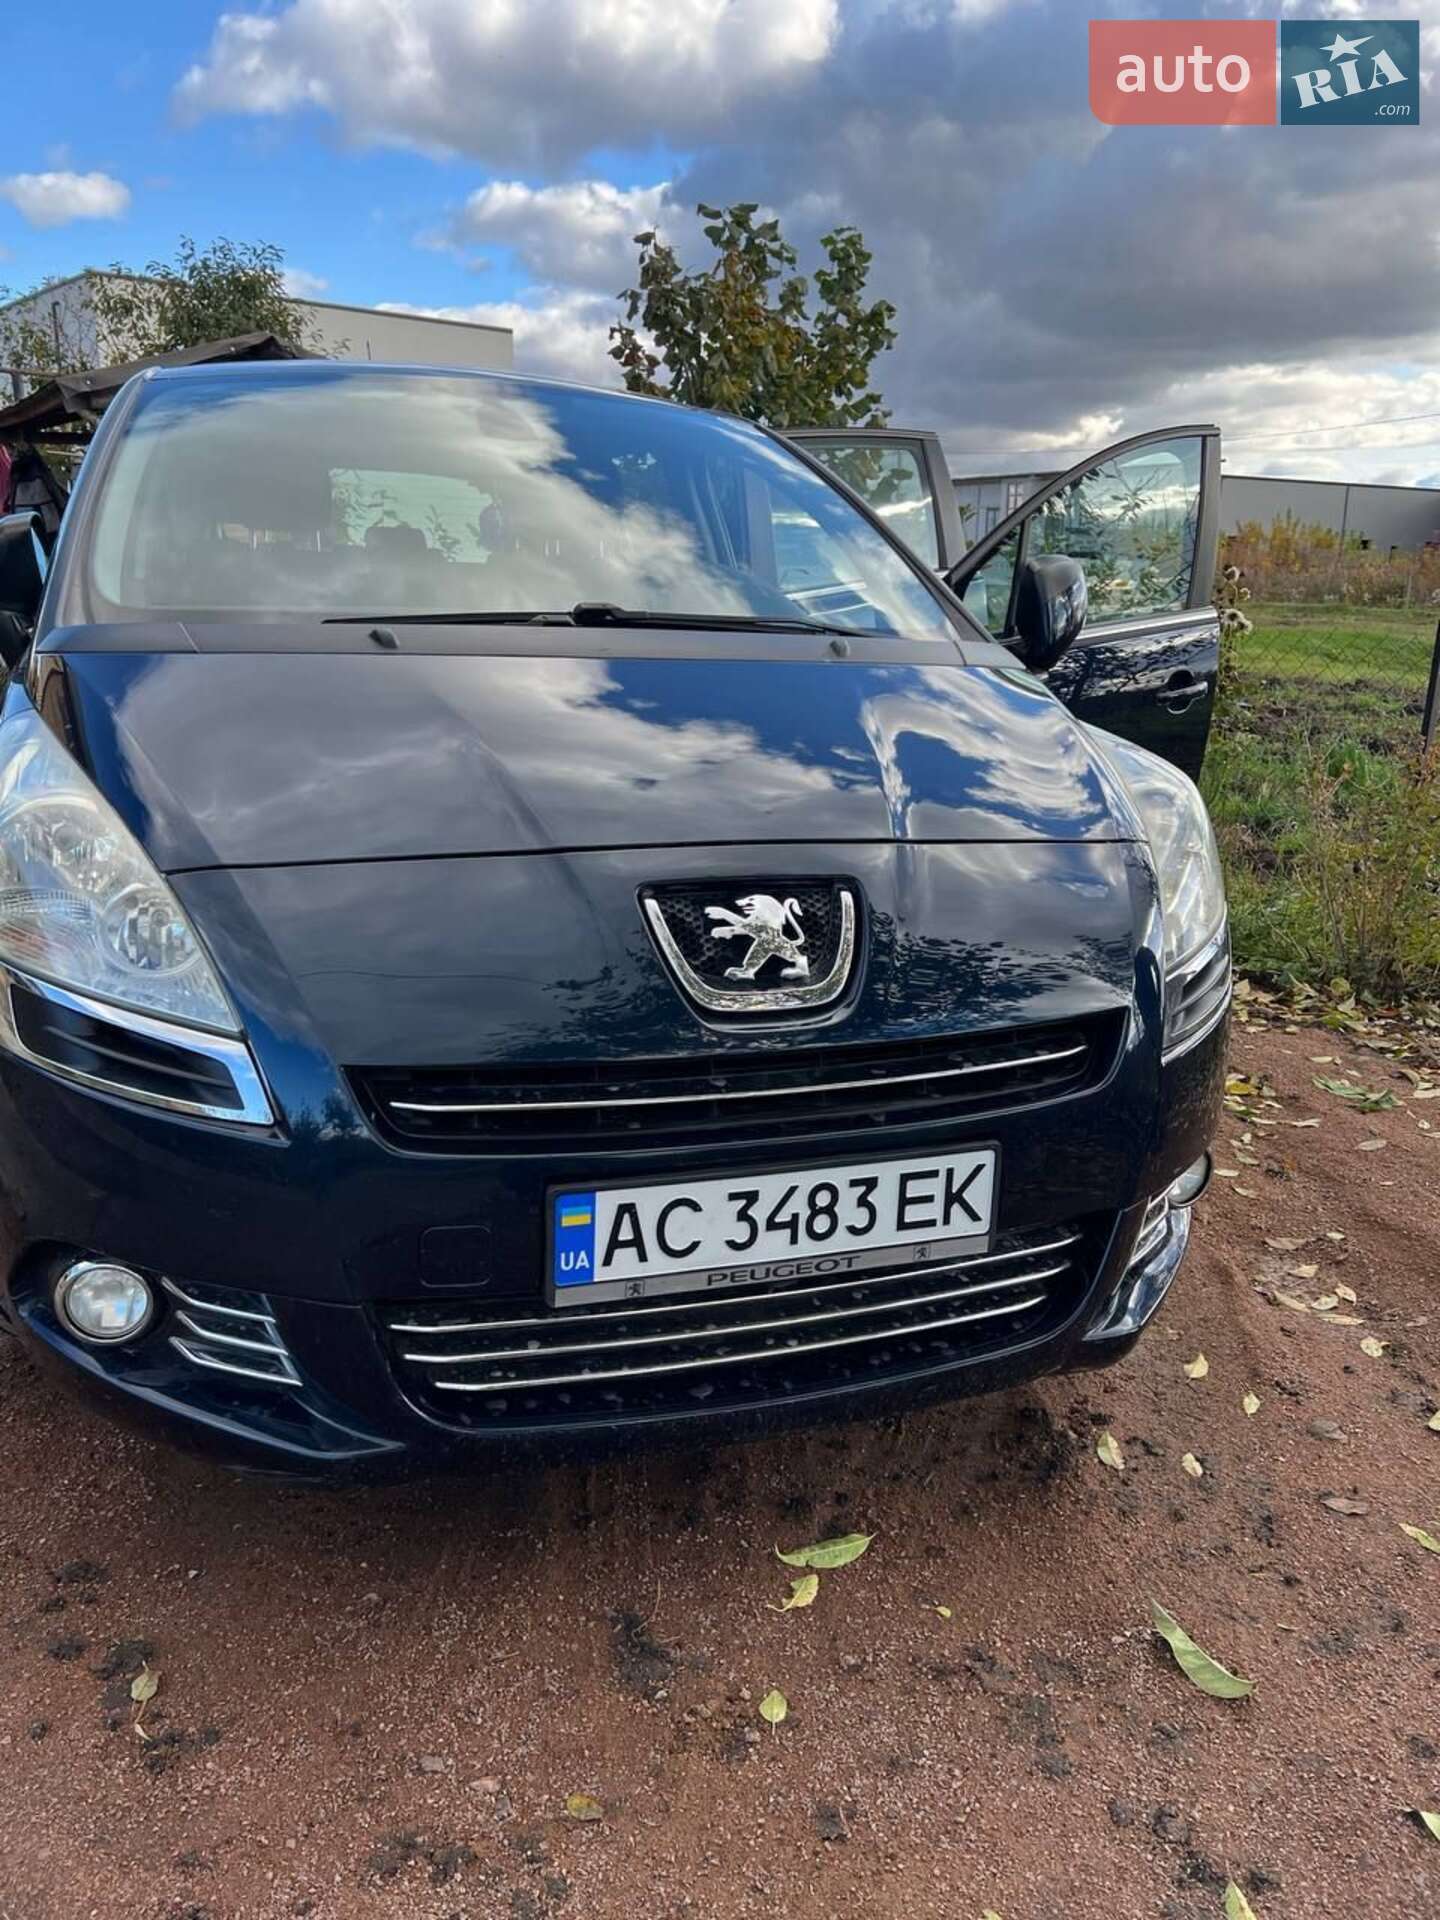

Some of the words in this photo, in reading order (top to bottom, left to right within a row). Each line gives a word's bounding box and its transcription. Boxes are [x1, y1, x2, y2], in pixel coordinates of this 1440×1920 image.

[602, 1197, 704, 1267] AC
[725, 1175, 880, 1252] 3483
[896, 1162, 987, 1232] EK
[560, 1250, 590, 1271] UA
[706, 1255, 861, 1286] PEUGEOT
